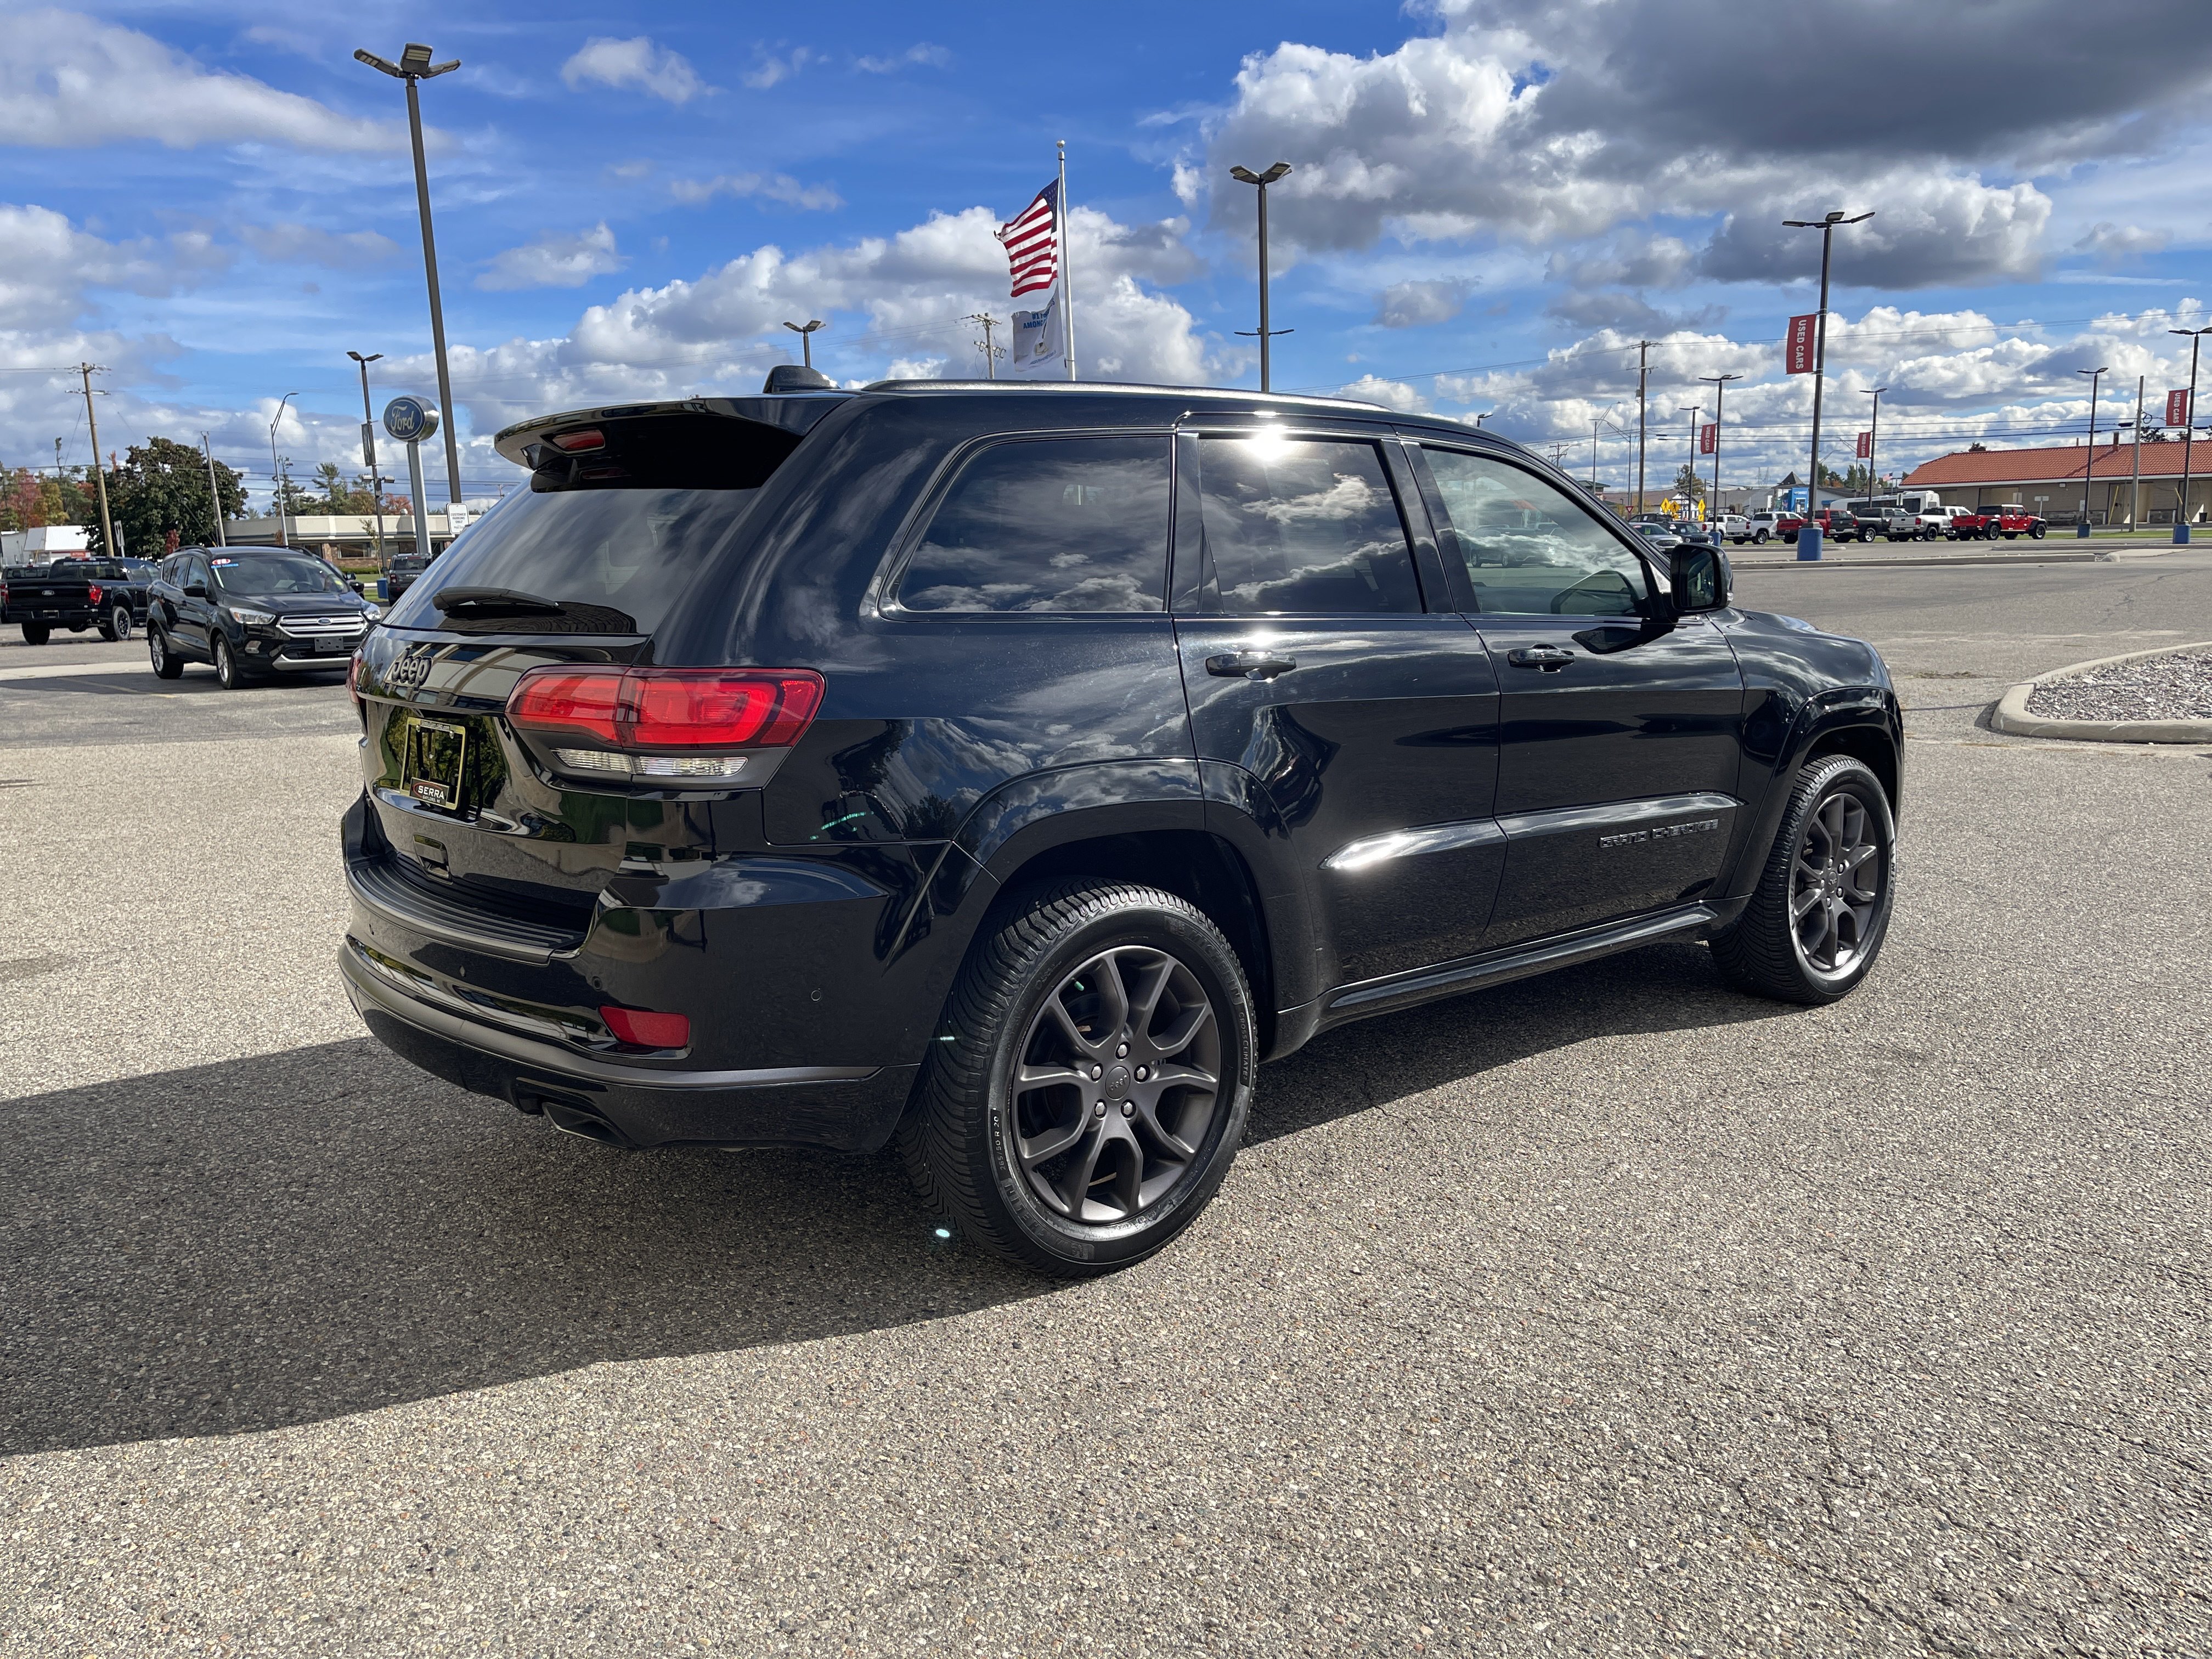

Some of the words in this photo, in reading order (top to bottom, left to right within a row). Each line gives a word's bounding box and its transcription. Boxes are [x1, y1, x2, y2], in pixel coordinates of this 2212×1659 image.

[1797, 319, 1807, 343] USED
[1796, 345, 1804, 369] CARS
[391, 405, 415, 431] Ford
[392, 647, 432, 691] Jeep
[417, 785, 444, 800] SERRA
[1598, 831, 1649, 848] GRAND
[1652, 819, 1719, 839] CHEROKEE
[994, 1116, 1000, 1128] 20
